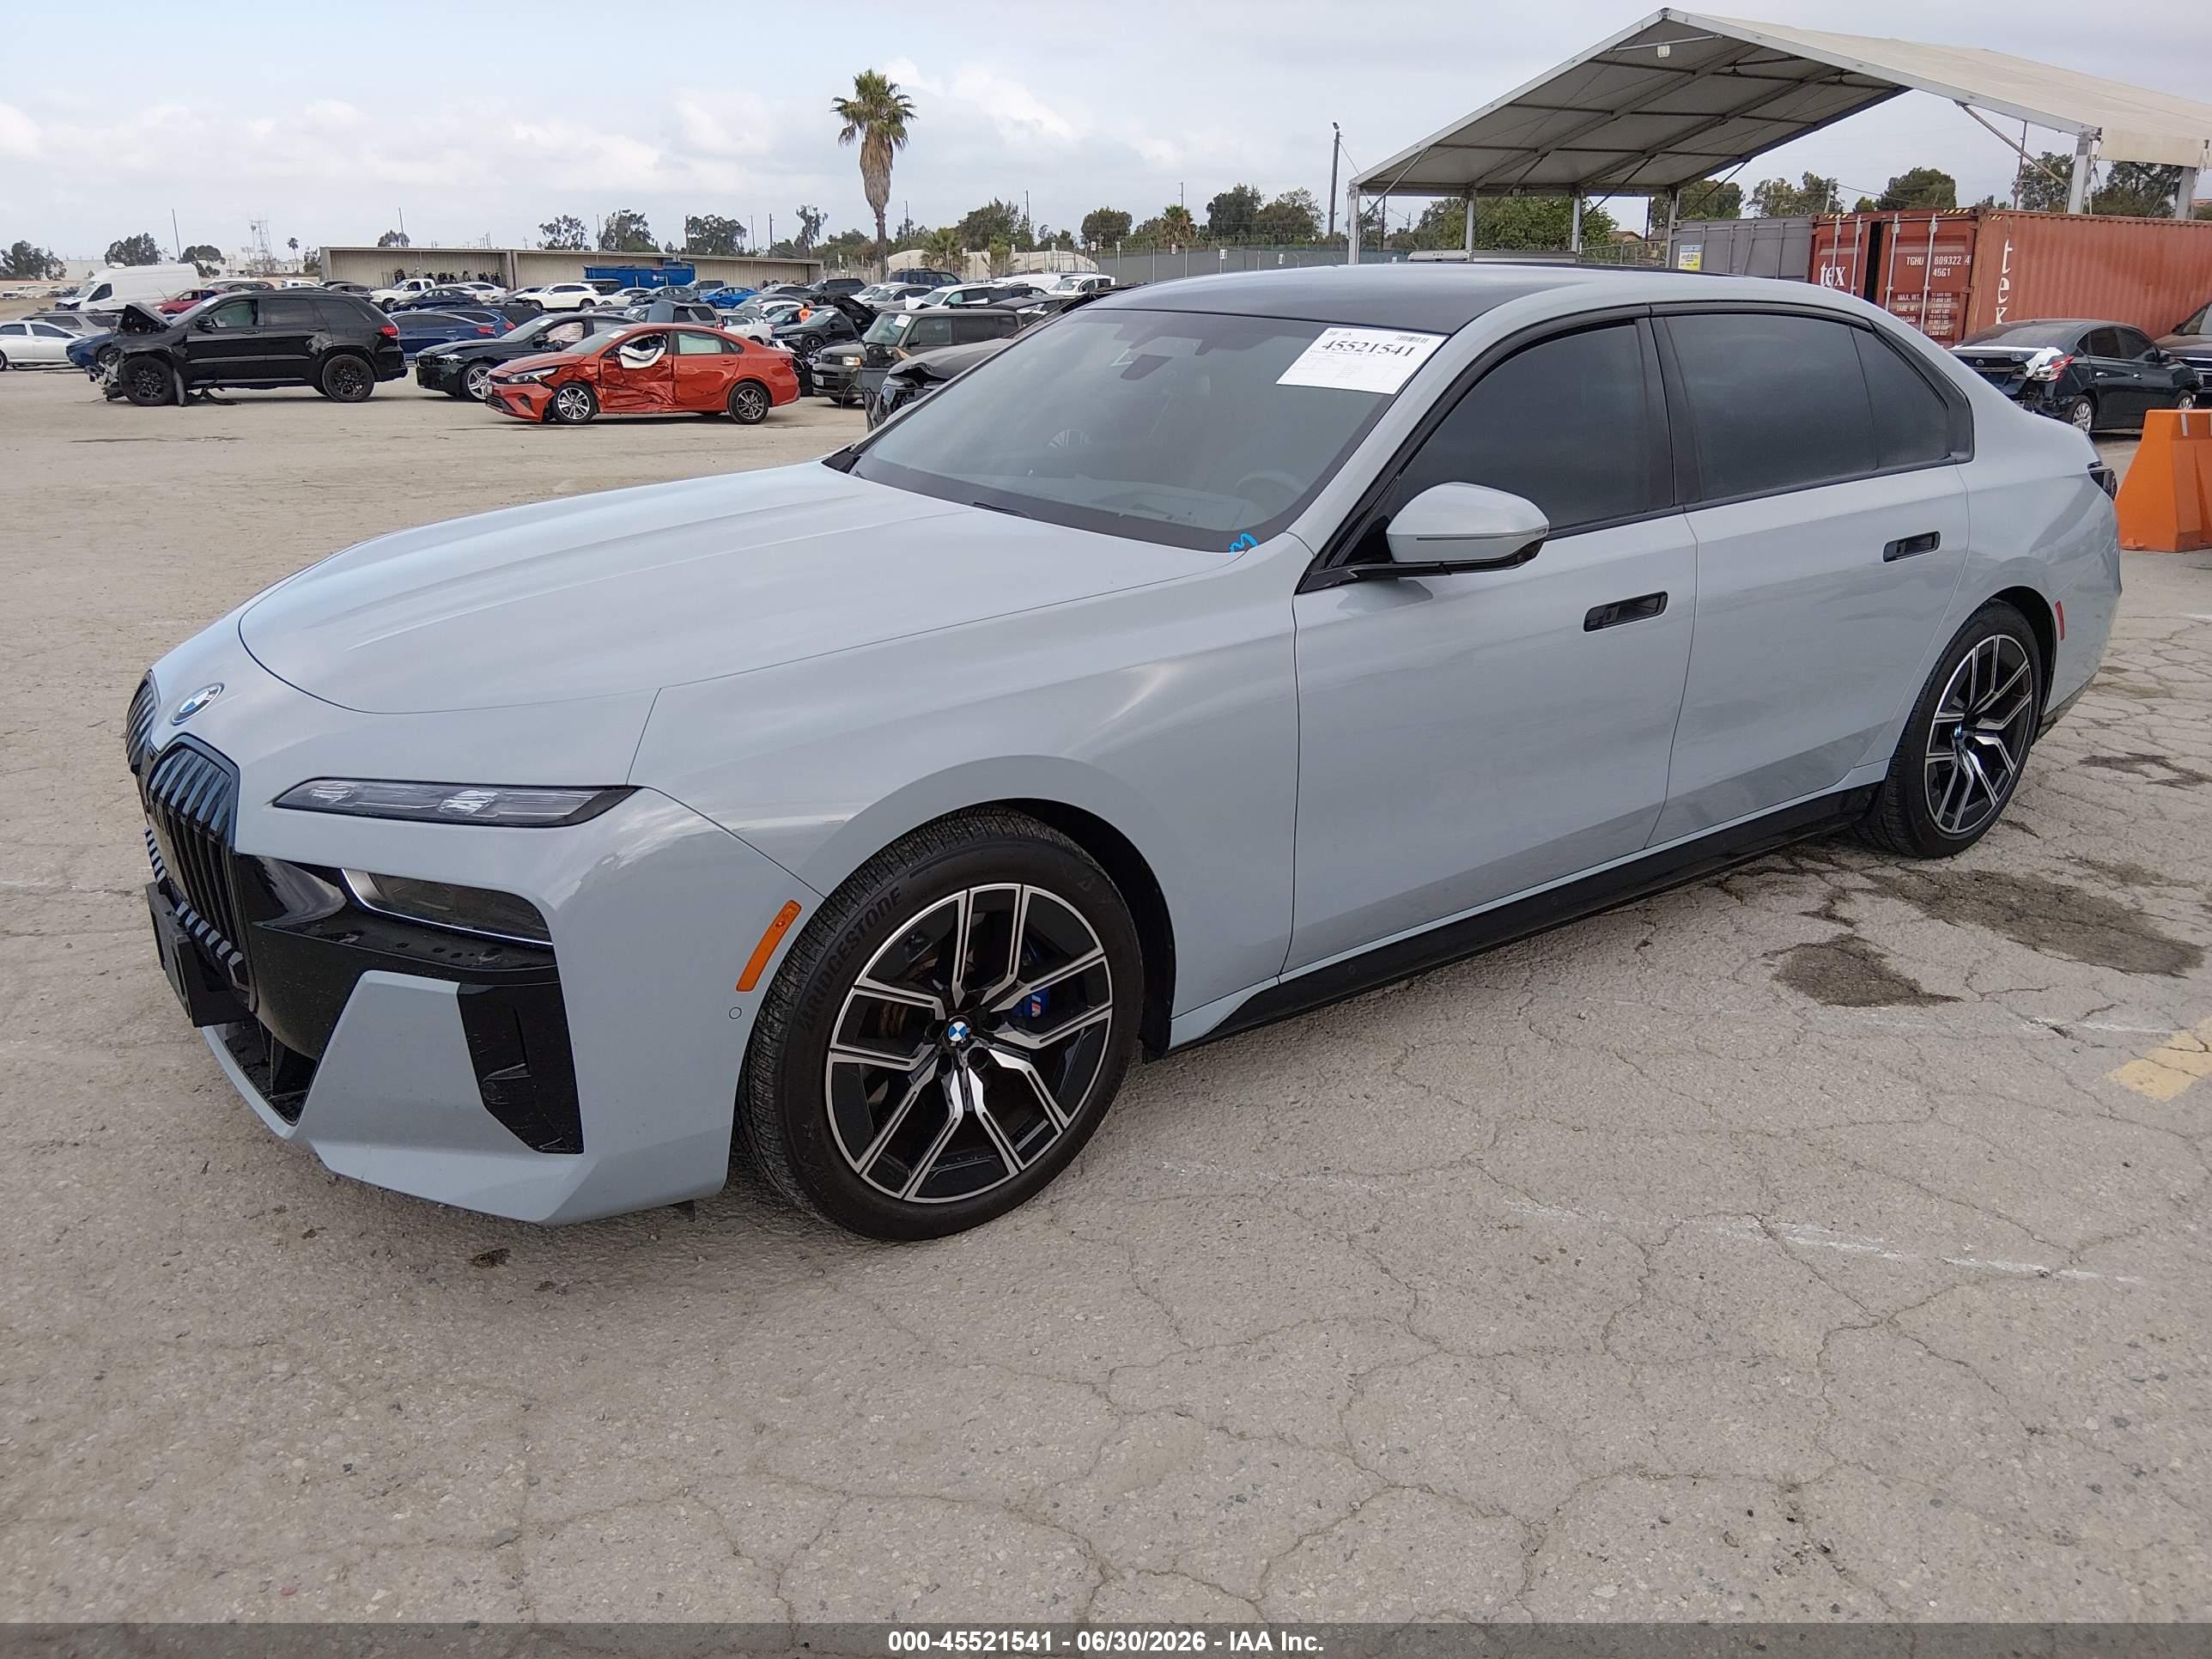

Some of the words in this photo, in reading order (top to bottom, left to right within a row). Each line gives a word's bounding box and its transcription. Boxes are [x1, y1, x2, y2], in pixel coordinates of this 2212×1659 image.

[1905, 256, 1924, 266] TGHU
[1934, 255, 1962, 265] 609322
[1820, 260, 1847, 288] tex
[1321, 339, 1416, 357] 45521541
[798, 886, 902, 1032] BRIDGESTONE
